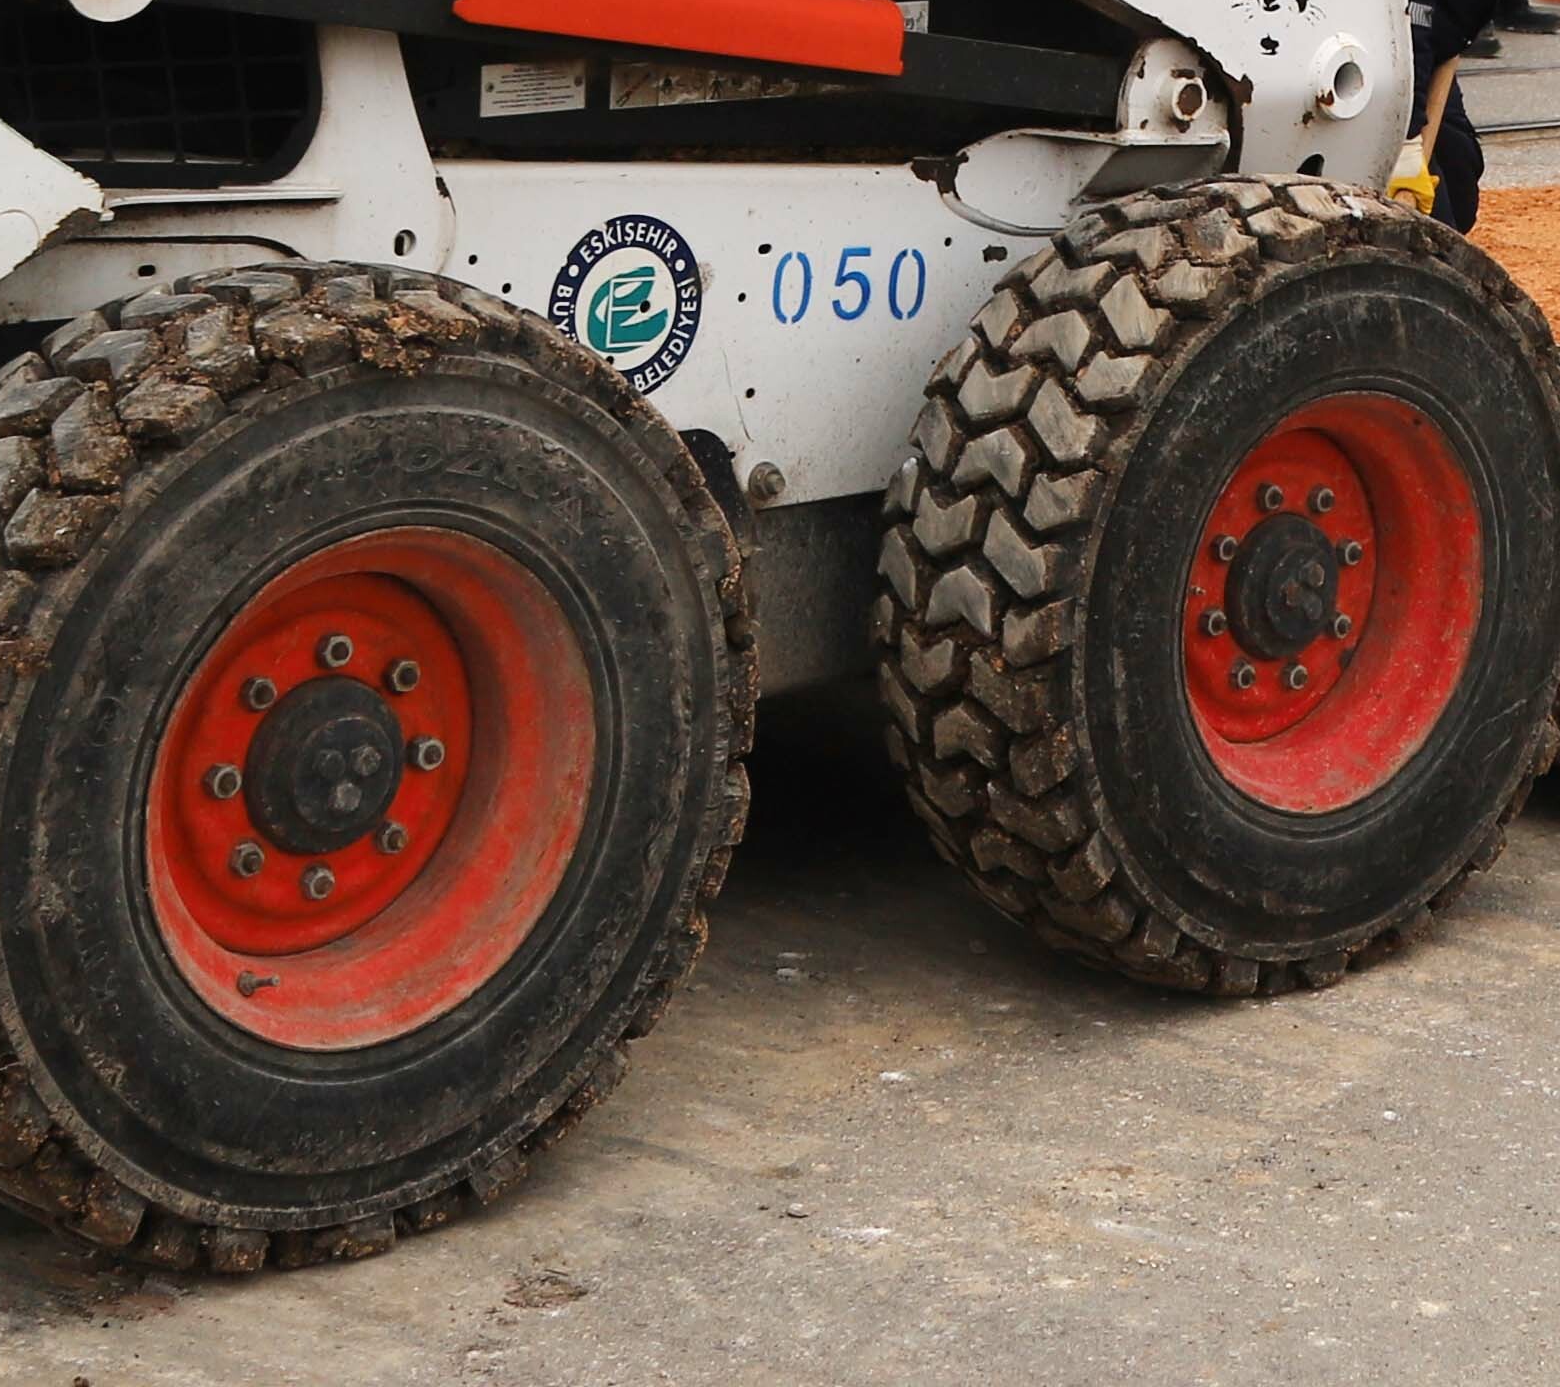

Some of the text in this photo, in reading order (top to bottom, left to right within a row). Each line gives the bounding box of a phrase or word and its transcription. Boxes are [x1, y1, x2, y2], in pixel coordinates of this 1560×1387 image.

[579, 221, 678, 264] ESKİŞEHİR
[771, 245, 927, 326] 050
[633, 277, 699, 393] BELEDİYESİ
